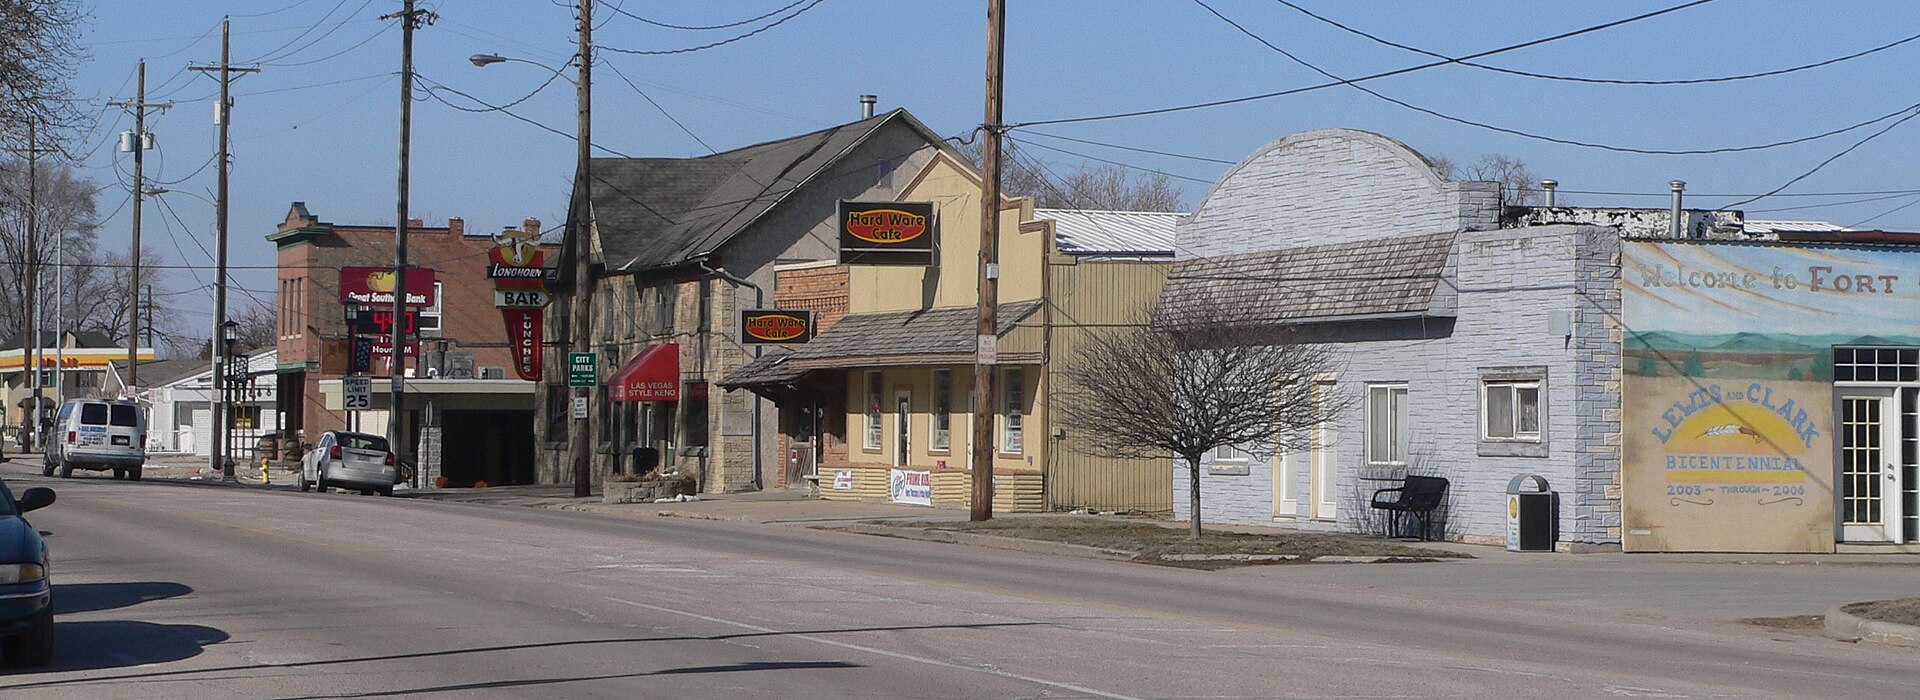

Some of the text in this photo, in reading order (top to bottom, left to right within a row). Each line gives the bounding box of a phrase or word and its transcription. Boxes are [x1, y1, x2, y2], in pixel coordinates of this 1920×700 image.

[850, 212, 924, 226] Hard Ware
[872, 228, 902, 240] Cafe
[492, 262, 542, 277] LONGHORN
[1638, 263, 1899, 294] Welcome to FORT
[348, 292, 370, 302] Great
[406, 293, 426, 304] Bank
[504, 292, 540, 305] BAR
[748, 318, 805, 327] Hard Ware
[765, 329, 788, 338] Cafe
[523, 313, 532, 373] LUNCHES
[346, 395, 368, 408] 25
[1651, 382, 1821, 448] LEWIS AND CLARK
[1666, 455, 1804, 471] BICENTENNIAL
[1667, 485, 1804, 496] 2003 THROUGH 2006
